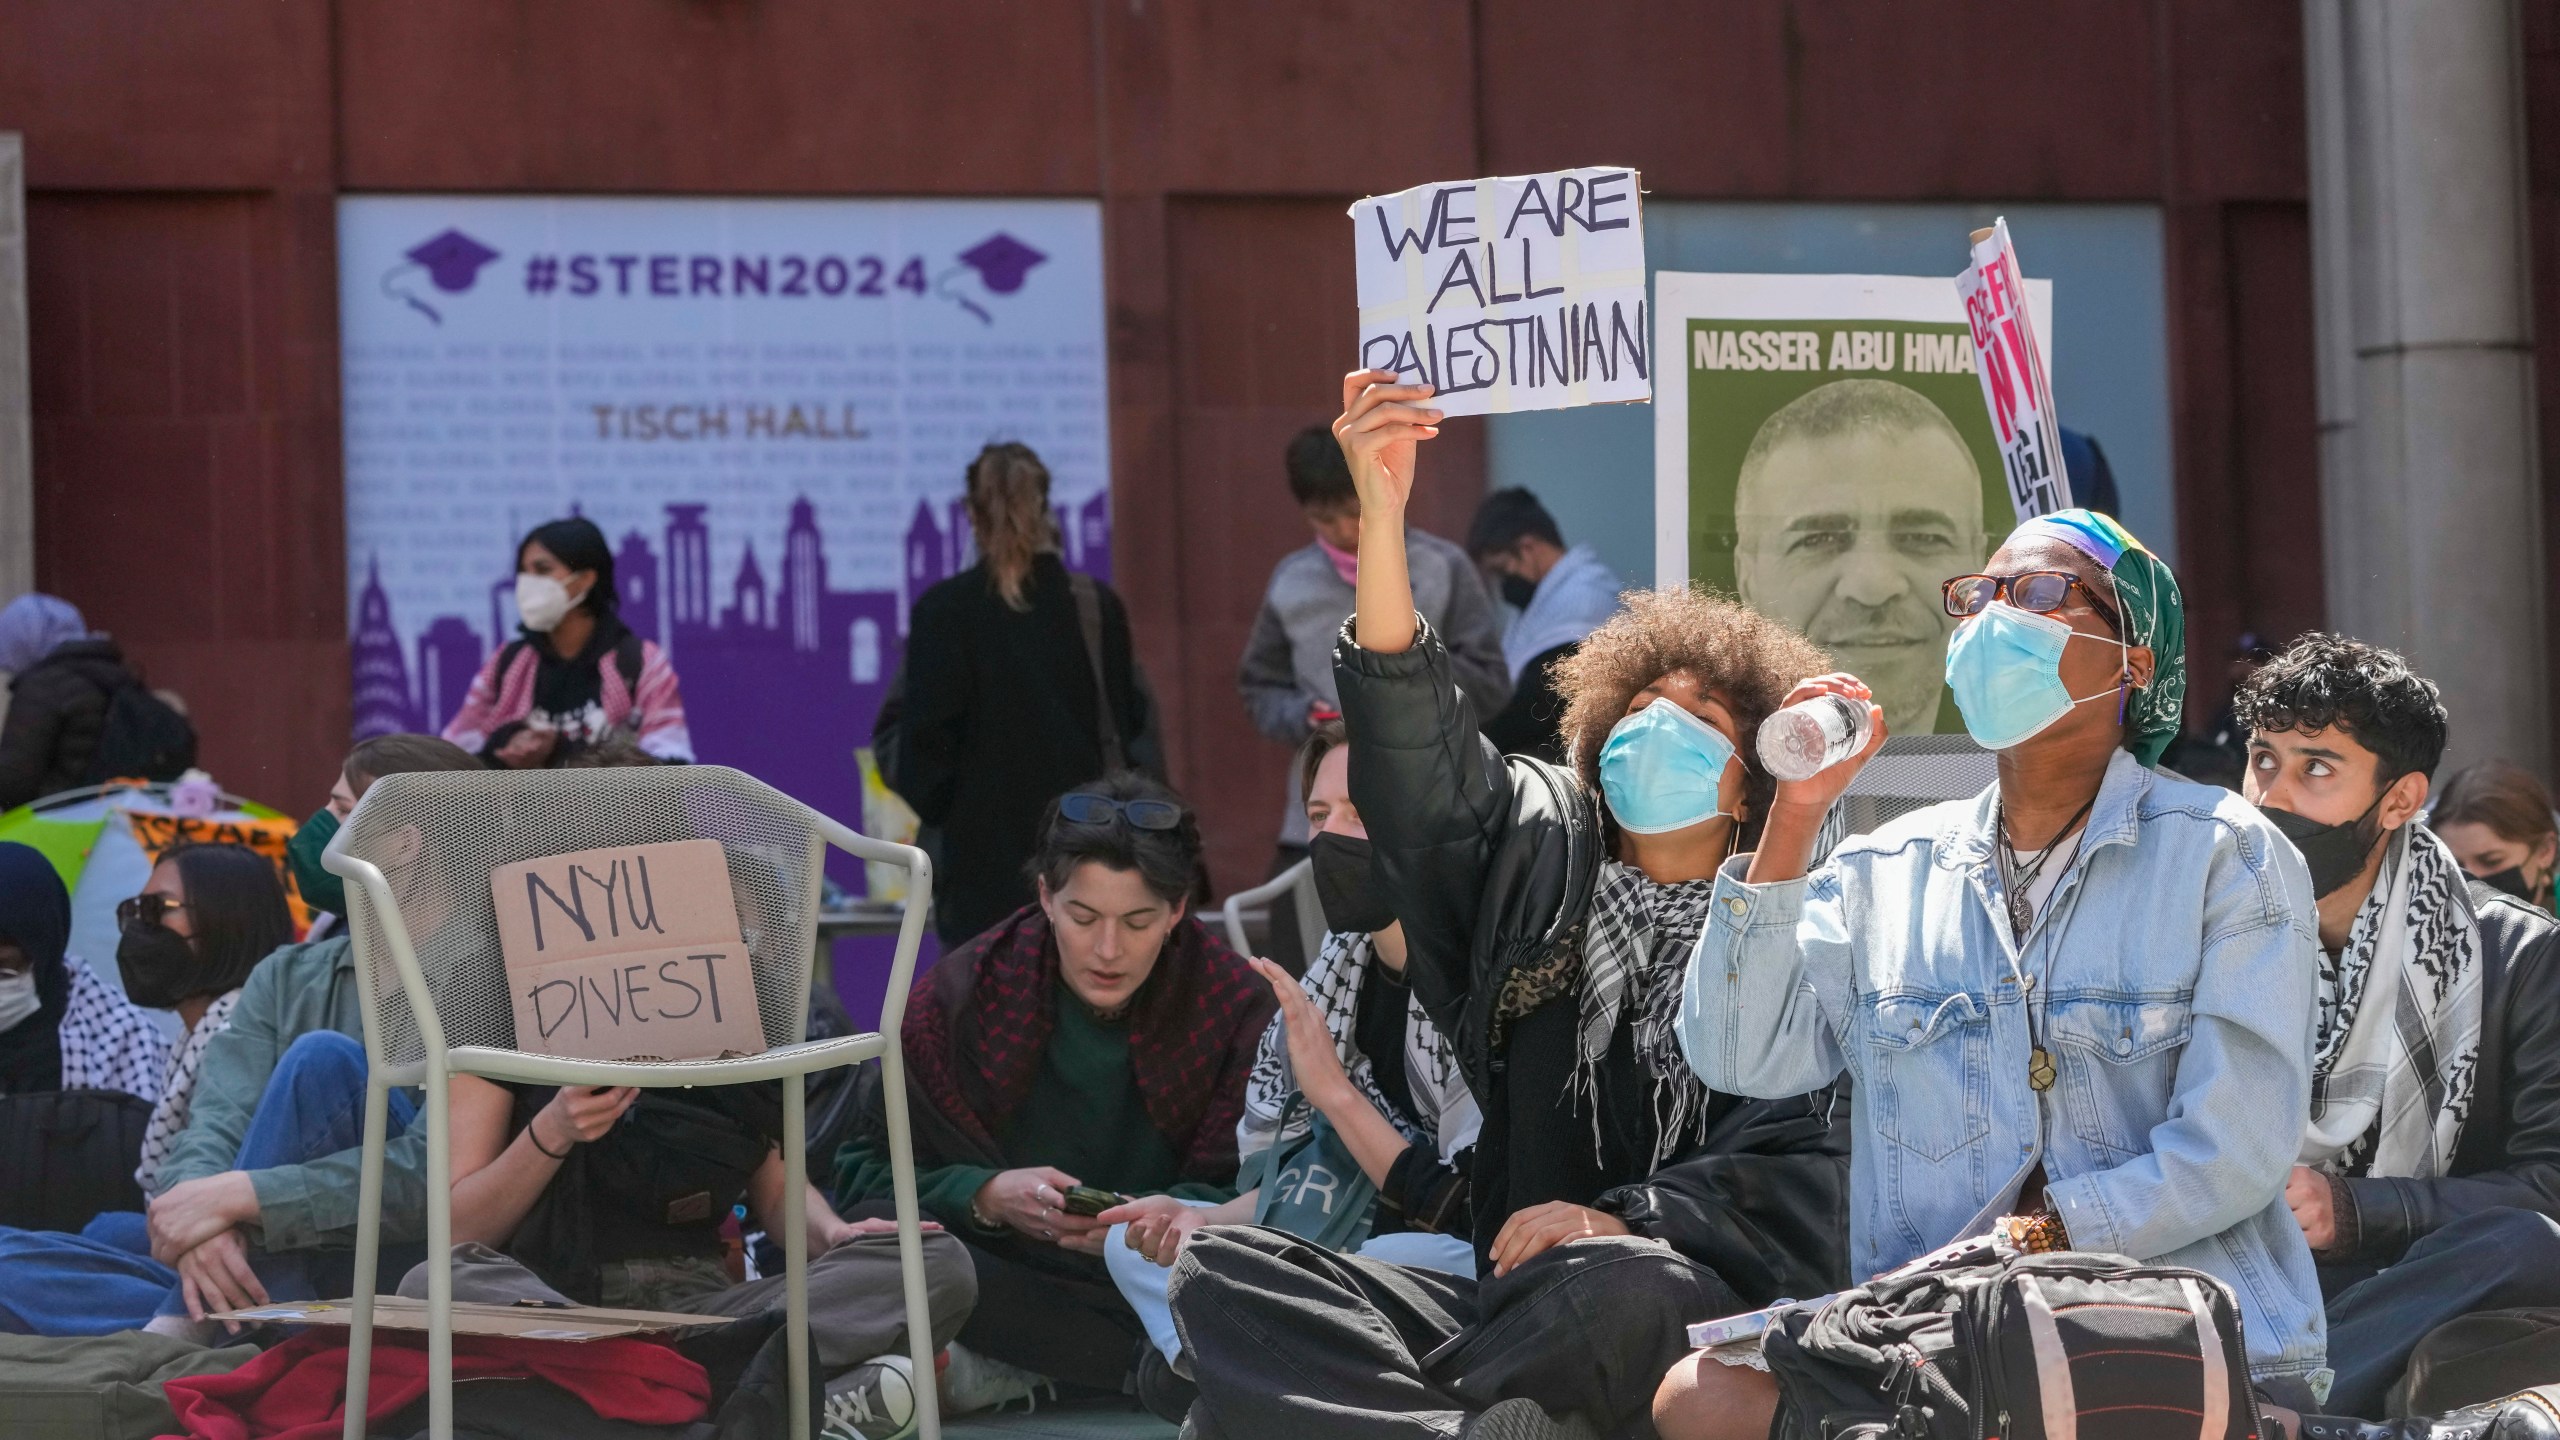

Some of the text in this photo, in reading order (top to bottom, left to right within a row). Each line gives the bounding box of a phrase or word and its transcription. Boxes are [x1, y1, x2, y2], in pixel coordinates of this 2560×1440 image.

[1376, 172, 1630, 262] WE ARE
[525, 254, 929, 296] #STERN2024
[1426, 237, 1565, 315] ALL
[1362, 300, 1649, 397] PALESTINIAN
[1693, 330, 1820, 372] NASSER
[1828, 330, 1896, 372] ABU
[592, 403, 868, 441] TISCH HALL
[526, 855, 665, 951] NYU
[528, 954, 726, 1039] DIVEST
